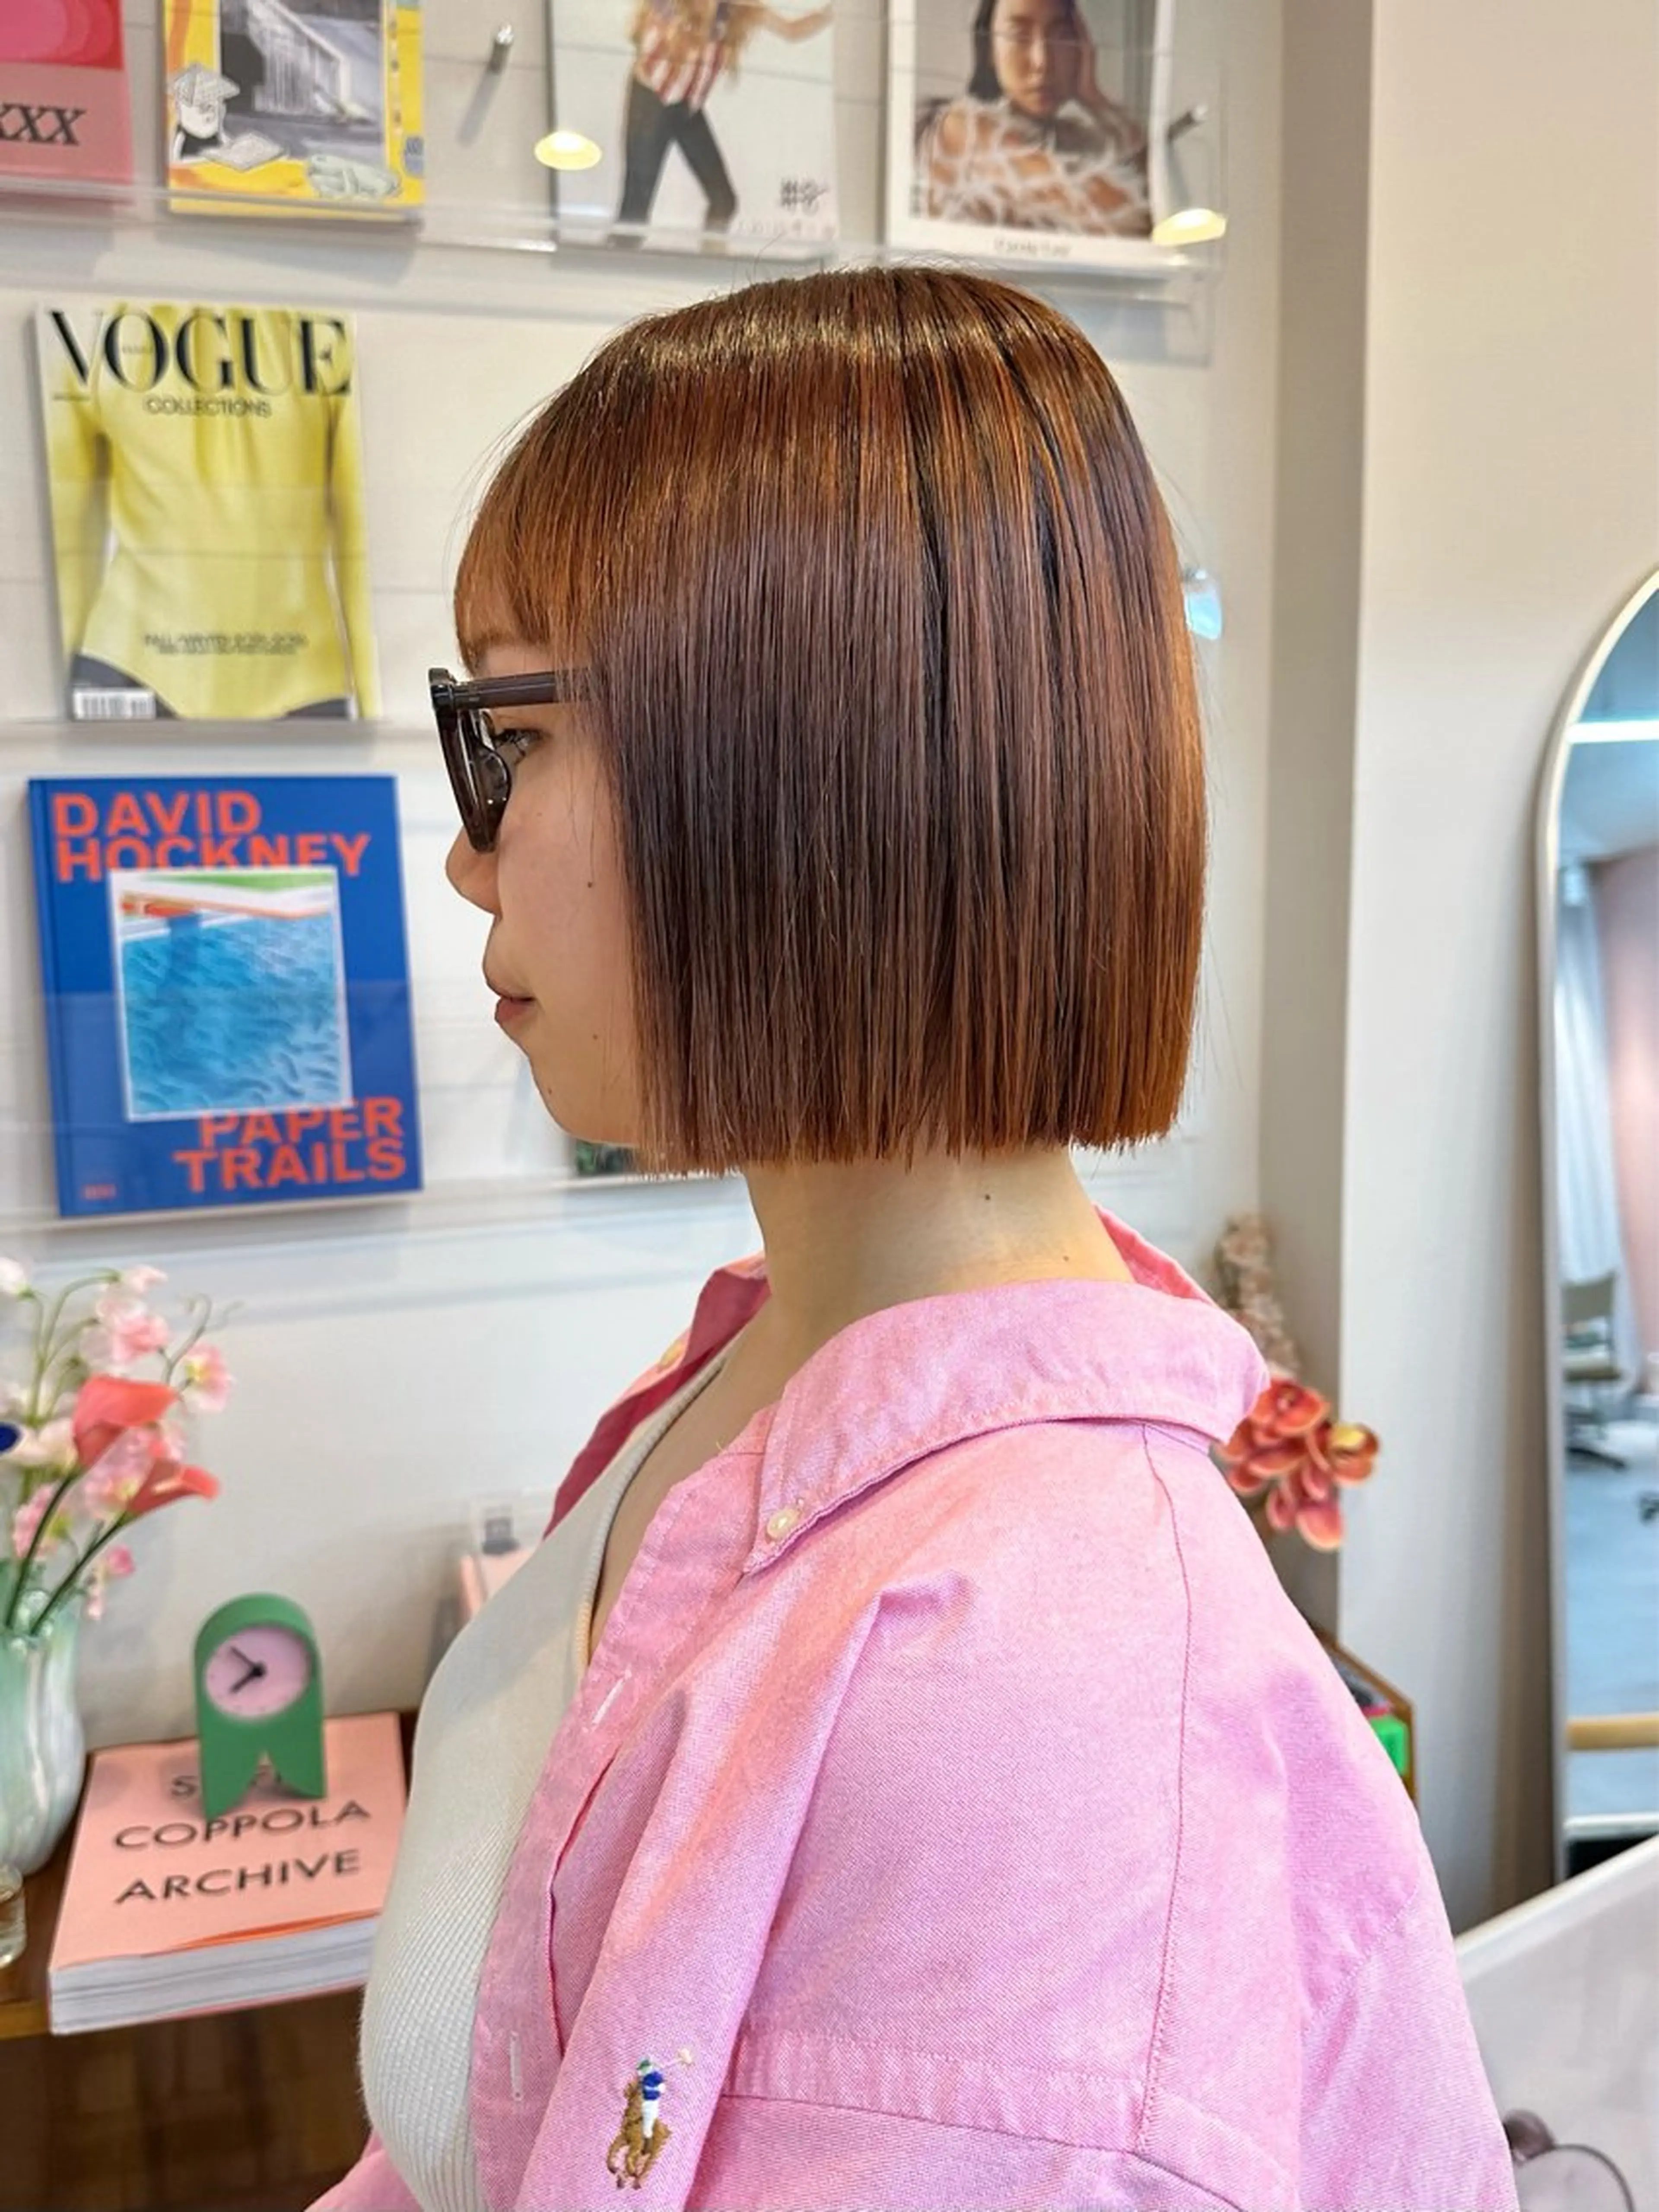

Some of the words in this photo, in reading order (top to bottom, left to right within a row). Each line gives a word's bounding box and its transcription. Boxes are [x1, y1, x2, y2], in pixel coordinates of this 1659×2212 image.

[48, 308, 351, 395] VOGUE
[143, 396, 272, 418] COLLECTIONS
[53, 791, 261, 836] DAVID
[56, 834, 370, 881] HOCKNEY
[199, 1096, 404, 1147] PAPER
[174, 1138, 405, 1192] TRAILS
[114, 1799, 372, 1850] COPPOLA
[114, 1849, 360, 1904] ARCHIVE
